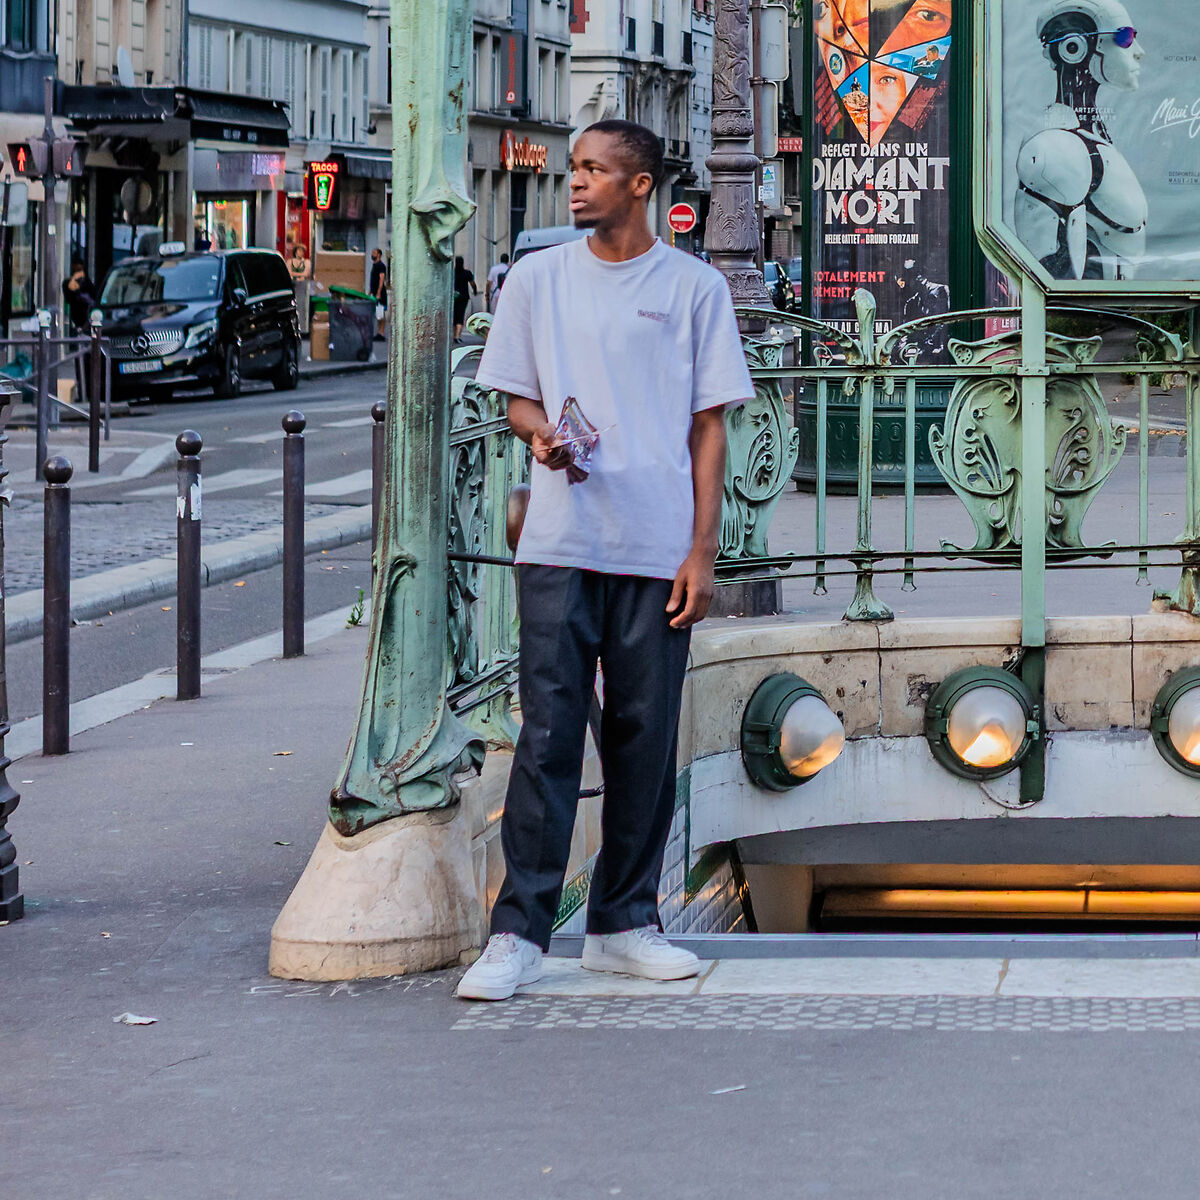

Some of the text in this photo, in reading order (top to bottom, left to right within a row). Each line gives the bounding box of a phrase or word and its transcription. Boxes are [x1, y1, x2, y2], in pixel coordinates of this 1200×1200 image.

[1151, 97, 1188, 125] Maui
[822, 143, 928, 157] REFLET DANS UN
[311, 162, 338, 172] TACOS
[812, 157, 950, 190] DIAMANT
[825, 190, 921, 224] MORT
[842, 322, 851, 334] AU
